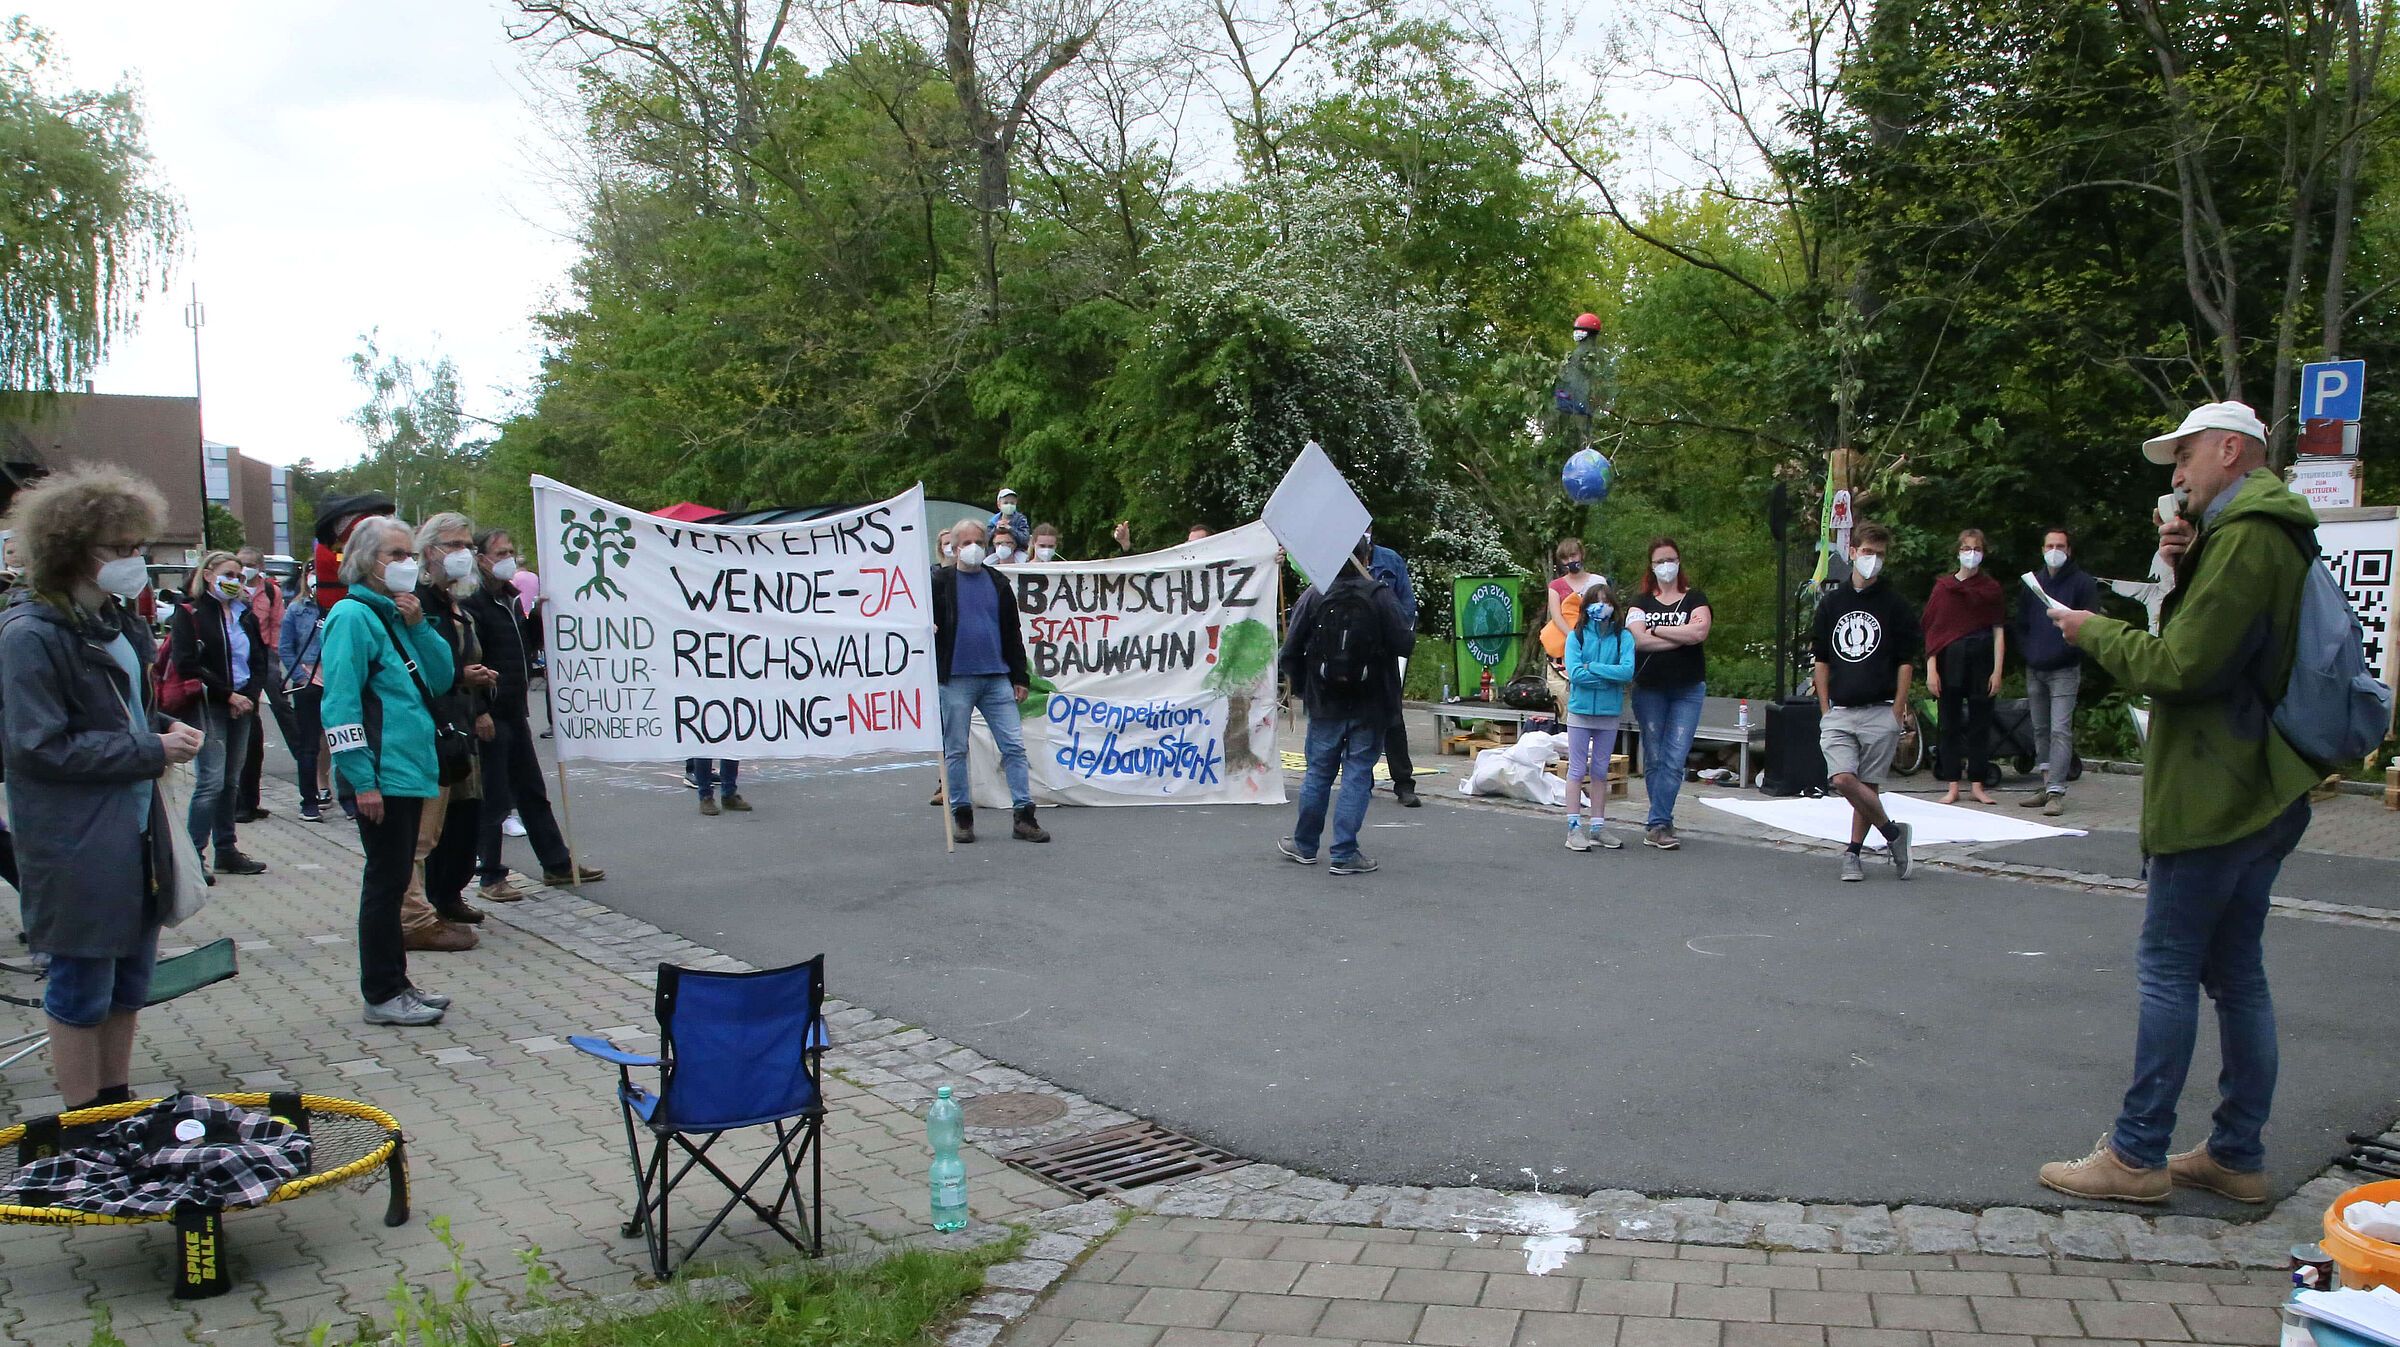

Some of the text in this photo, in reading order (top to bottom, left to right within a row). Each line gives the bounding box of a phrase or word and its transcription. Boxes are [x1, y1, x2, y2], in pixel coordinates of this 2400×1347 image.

[2314, 370, 2349, 415] P
[669, 565, 918, 618] WENDE-JA
[1017, 560, 1258, 615] BAUMSCHUTZ
[556, 614, 656, 653] BUND
[1028, 615, 1120, 644] STATT
[556, 657, 657, 685] NATUR-
[672, 629, 925, 681] REICHSWALD-
[557, 687, 658, 714] SCHUTZ
[675, 687, 922, 744] RODUNG-NEIN
[559, 716, 663, 740] NÜRNBERG
[185, 1230, 202, 1285] SPIKE
[201, 1235, 216, 1280] BALL
